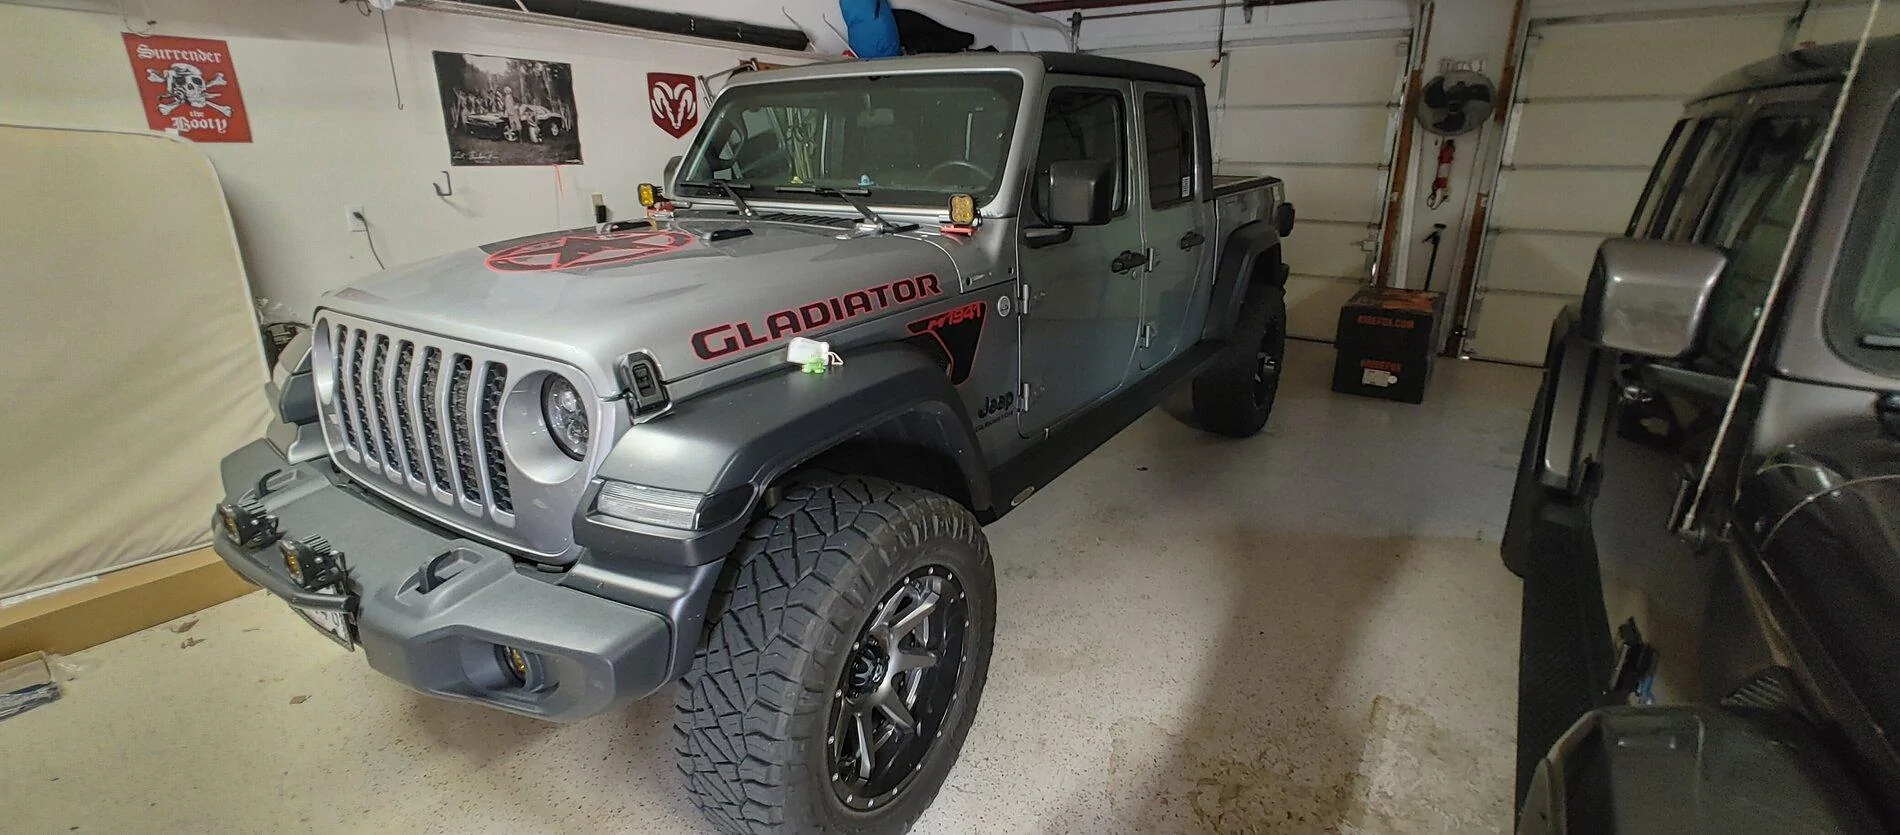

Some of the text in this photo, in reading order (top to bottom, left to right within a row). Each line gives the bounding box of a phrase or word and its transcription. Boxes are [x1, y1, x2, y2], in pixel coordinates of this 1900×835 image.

[136, 44, 222, 63] Surrender
[189, 110, 205, 118] the
[171, 116, 228, 134] Booty
[690, 272, 943, 361] GLADIATOR
[978, 391, 1014, 419] Jeep
